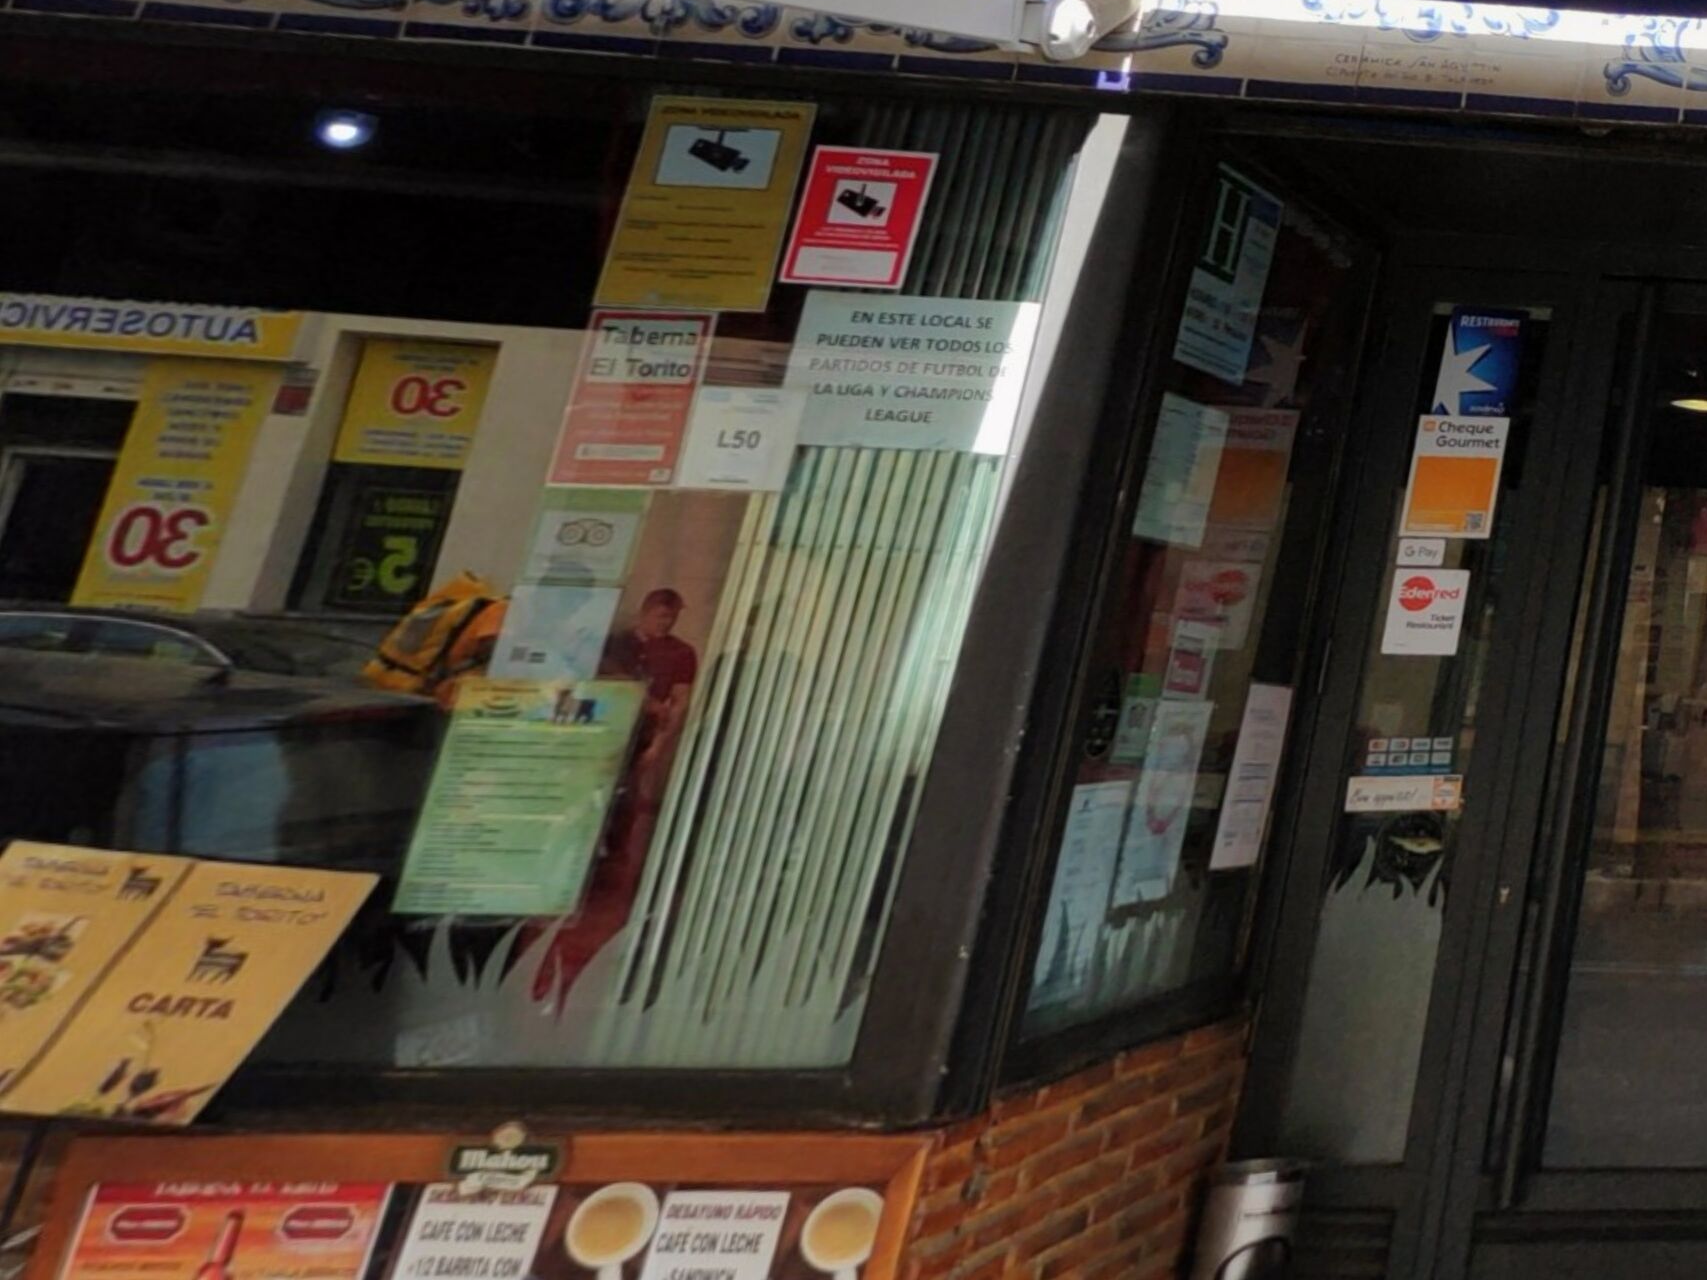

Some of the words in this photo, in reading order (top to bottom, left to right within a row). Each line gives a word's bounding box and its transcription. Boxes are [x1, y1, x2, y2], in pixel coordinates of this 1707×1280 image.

[851, 310, 873, 324] EN
[878, 311, 916, 326] ESTE
[920, 313, 972, 329] LOCAL
[975, 316, 994, 330] SE
[601, 325, 697, 346] Taberna
[816, 332, 885, 349] PUEDEN
[889, 336, 920, 350] VER
[926, 338, 981, 353] TODOS
[984, 340, 1014, 355] LOS
[590, 357, 617, 376] El
[626, 357, 691, 378] Torito
[808, 357, 891, 373] PARTIDOS
[896, 360, 917, 375] DE
[922, 362, 985, 377] FUTBOL
[812, 381, 833, 396] LA
[837, 383, 873, 397] LIGA
[880, 384, 889, 397] Y
[893, 384, 994, 403] CHAMPIONS
[864, 407, 933, 424] LEAGUE
[1438, 420, 1495, 436] Cheque
[716, 428, 762, 450] L50
[1435, 435, 1501, 449] Gourmet
[1399, 586, 1460, 600] Edenred
[127, 991, 235, 1021] CARTA
[459, 1148, 550, 1172] Mahou
[484, 1221, 530, 1244] LECHE
[690, 1233, 719, 1254] CON
[719, 1232, 764, 1254] LECHE
